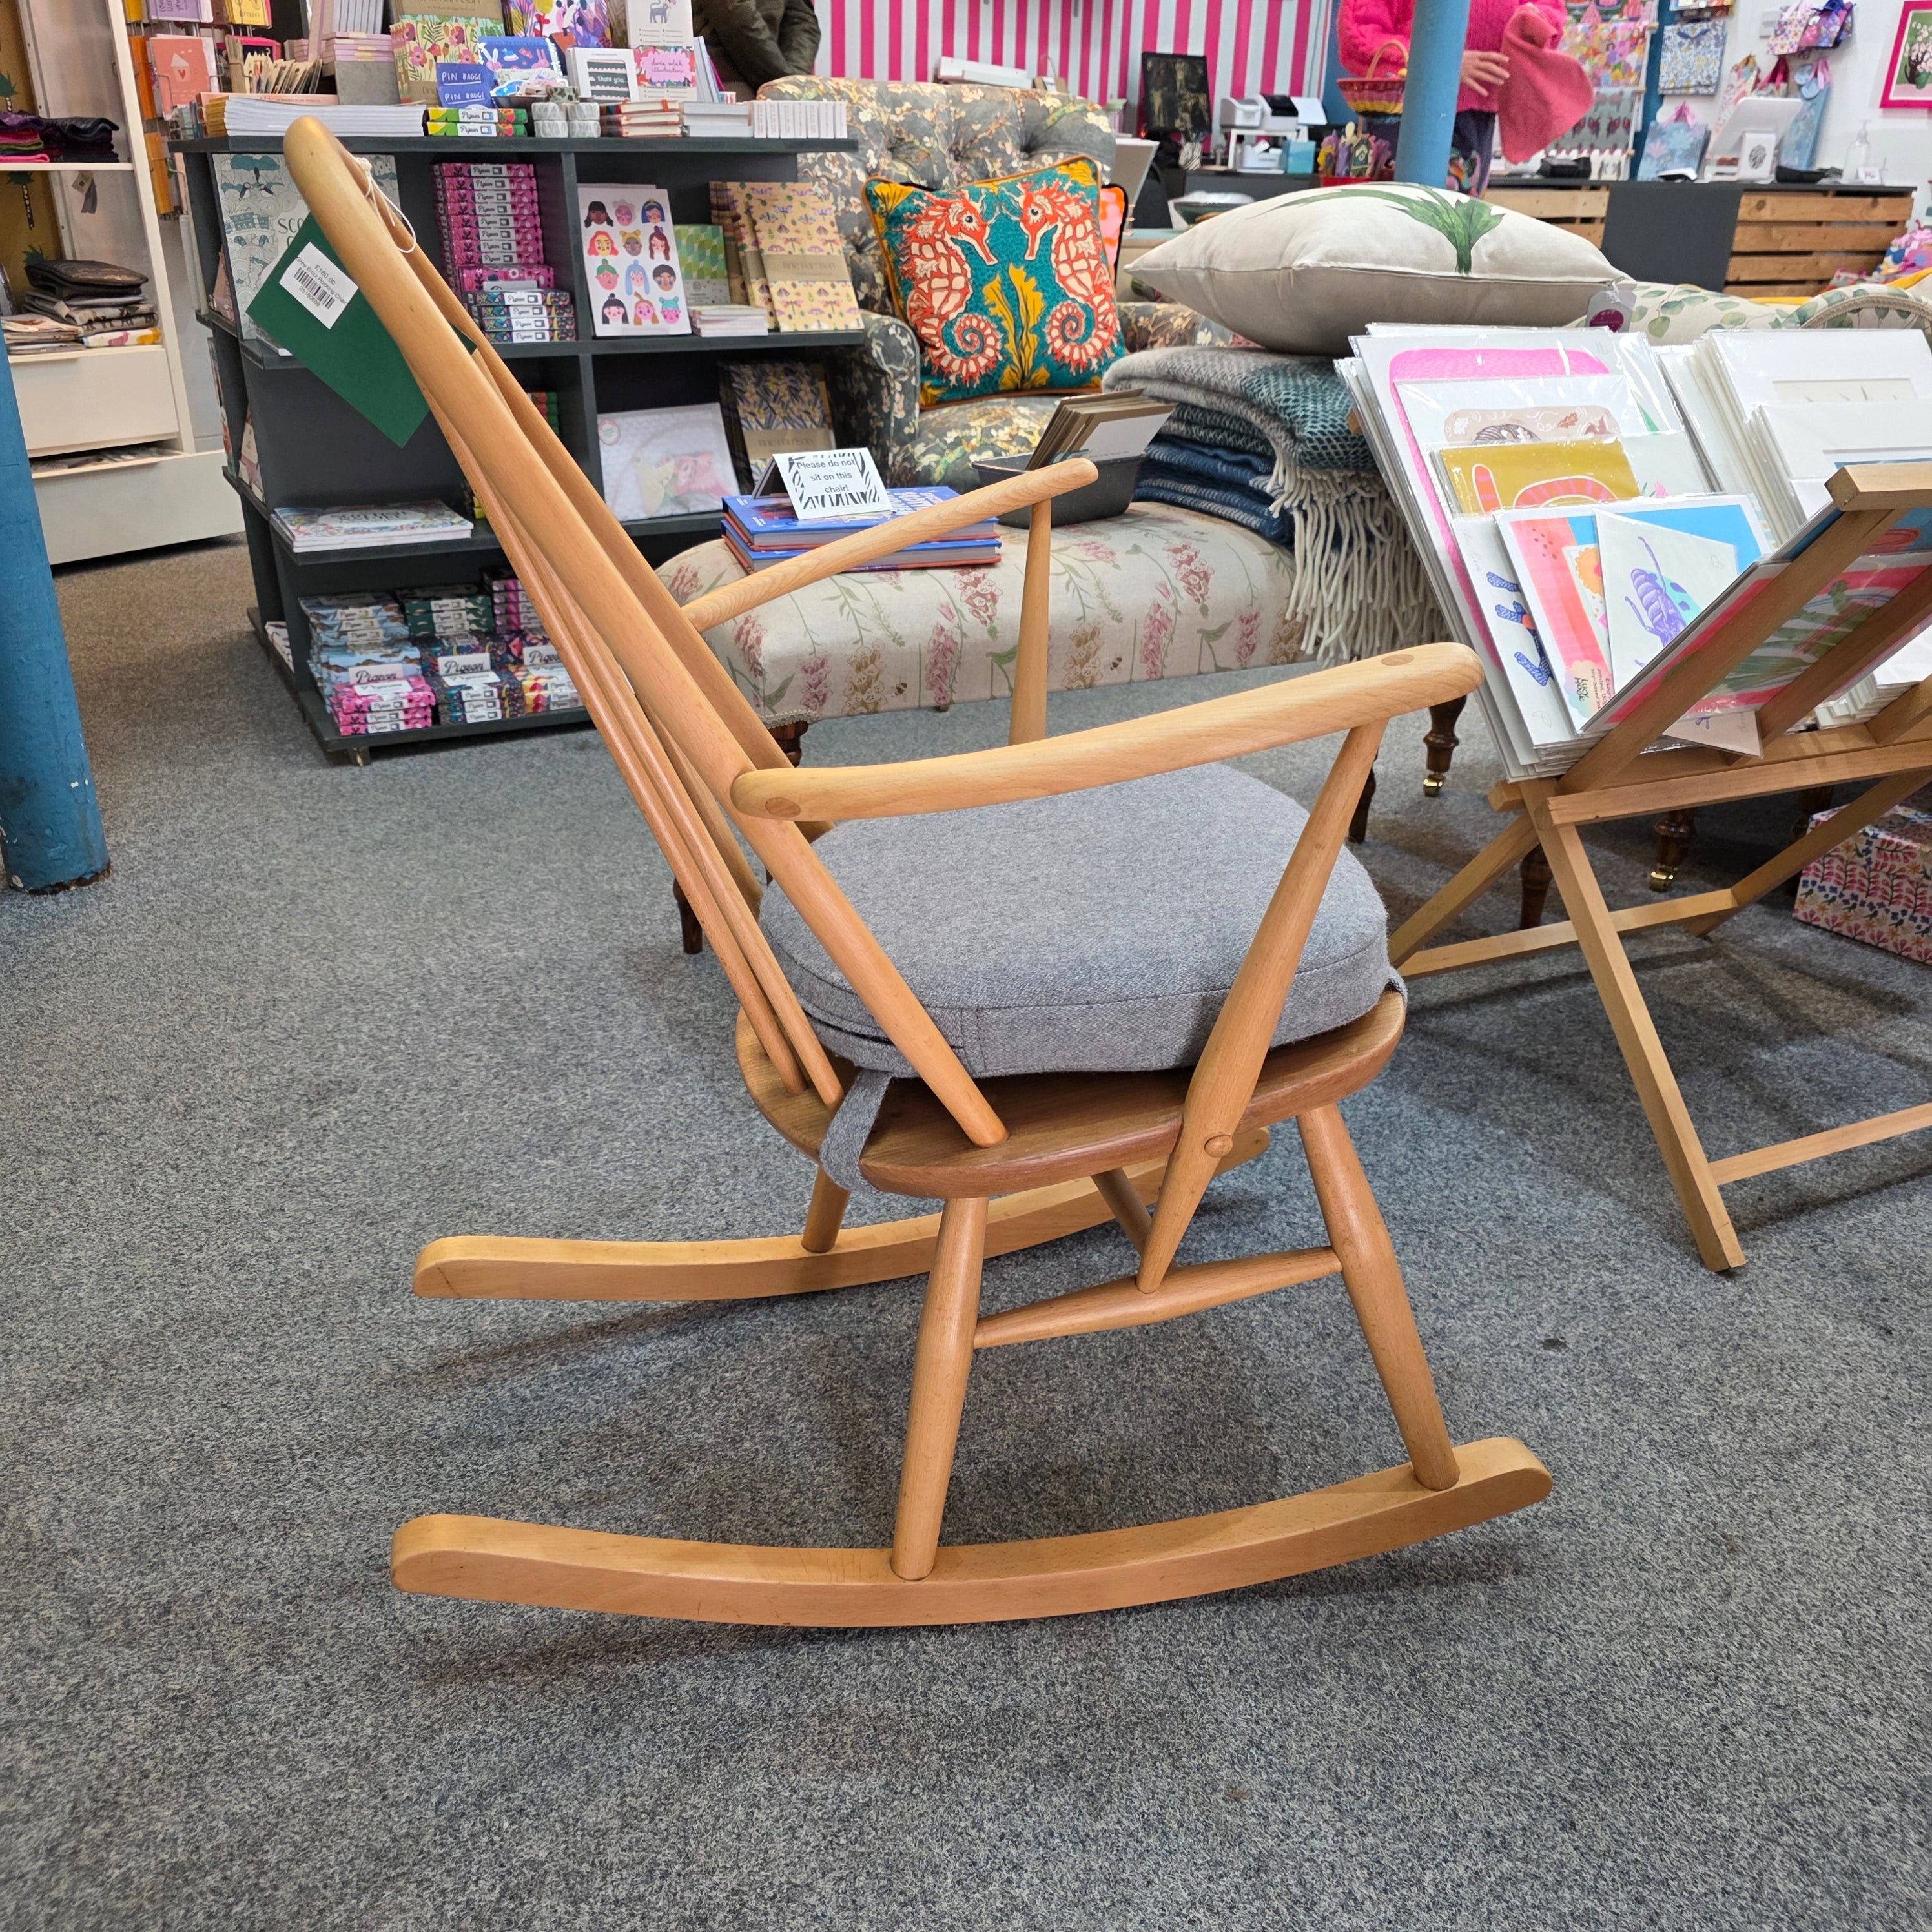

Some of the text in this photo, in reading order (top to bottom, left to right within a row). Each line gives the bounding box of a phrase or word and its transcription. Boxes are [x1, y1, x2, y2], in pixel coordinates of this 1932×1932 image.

[442, 71, 458, 81] PIN
[444, 92, 461, 101] PIN
[296, 256, 306, 268] Grey
[318, 277, 334, 295] Rocking
[334, 293, 347, 305] Chair
[796, 461, 826, 469] Please
[824, 484, 850, 493] chair!
[529, 650, 560, 664] Pigeo
[444, 660, 484, 673] Pigeon
[355, 669, 396, 683] Pigeon
